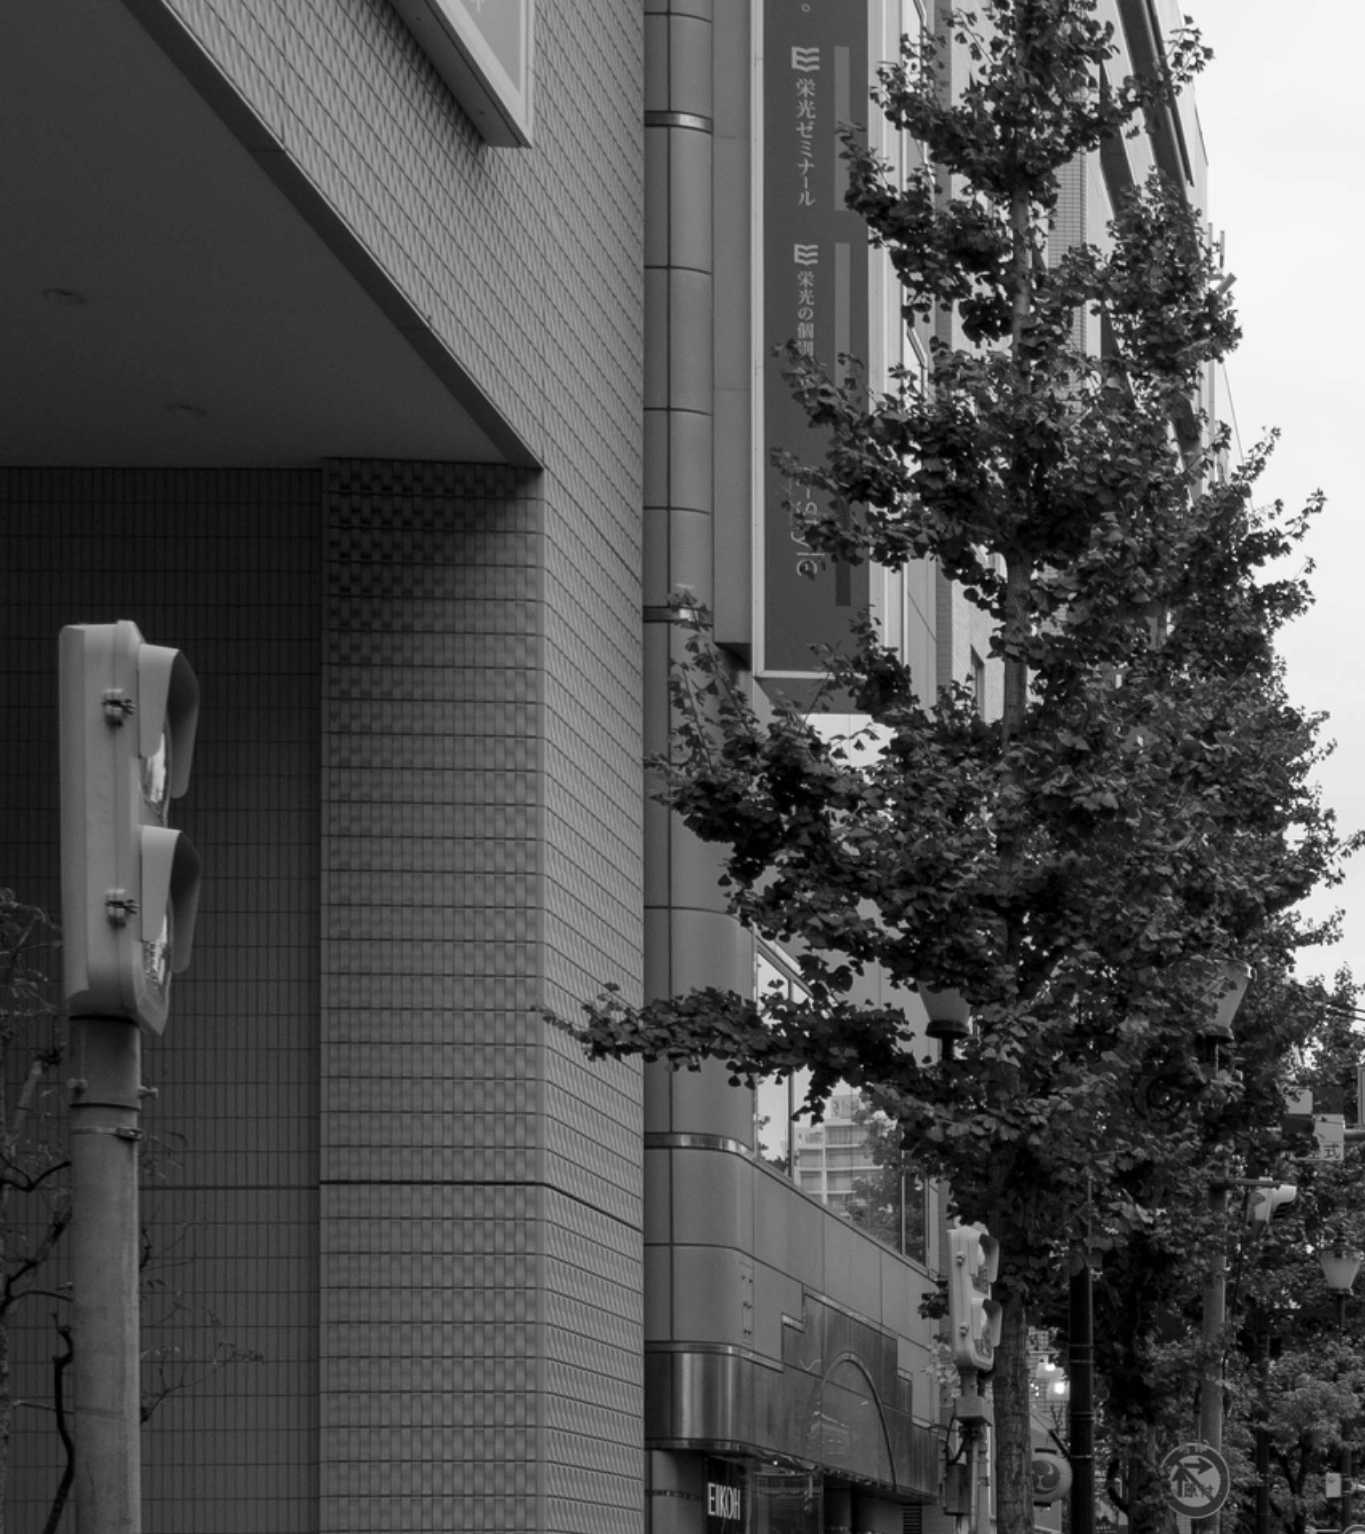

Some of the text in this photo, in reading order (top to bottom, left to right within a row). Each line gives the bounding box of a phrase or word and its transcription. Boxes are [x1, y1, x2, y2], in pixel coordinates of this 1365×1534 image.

[796, 78, 816, 206] 栄光ゼミナール
[708, 1482, 741, 1520] EIKOH
